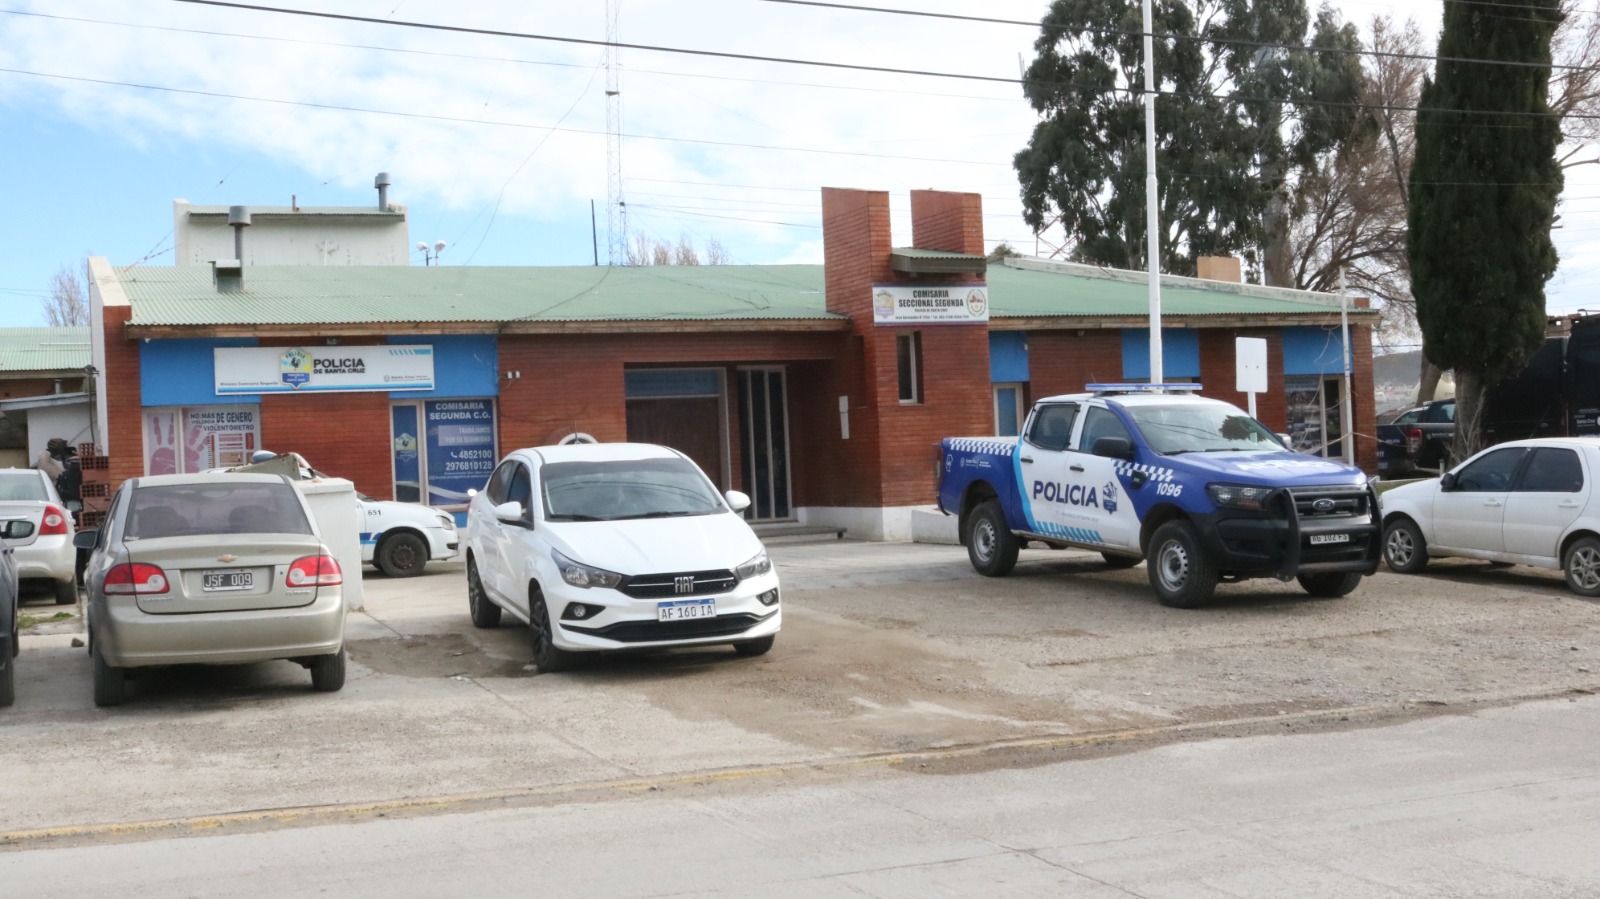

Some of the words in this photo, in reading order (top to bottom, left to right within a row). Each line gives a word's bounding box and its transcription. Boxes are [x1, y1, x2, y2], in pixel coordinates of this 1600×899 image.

[912, 290, 949, 298] COMISARIA
[898, 299, 934, 308] SECCIONAL
[935, 299, 964, 307] SEGUNDA
[313, 359, 365, 368] POLICIA
[435, 402, 485, 410] COMISARIA
[216, 413, 225, 423] DE
[459, 450, 492, 458] 4852100
[446, 461, 492, 470] 2976810128
[1033, 480, 1099, 508] POLICIA
[1156, 482, 1183, 497] 1096
[205, 574, 224, 587] JSF
[232, 573, 252, 585] 009
[674, 576, 694, 593] FIAT
[662, 608, 673, 619] AF
[678, 606, 696, 618] 160
[701, 606, 713, 616] IA
